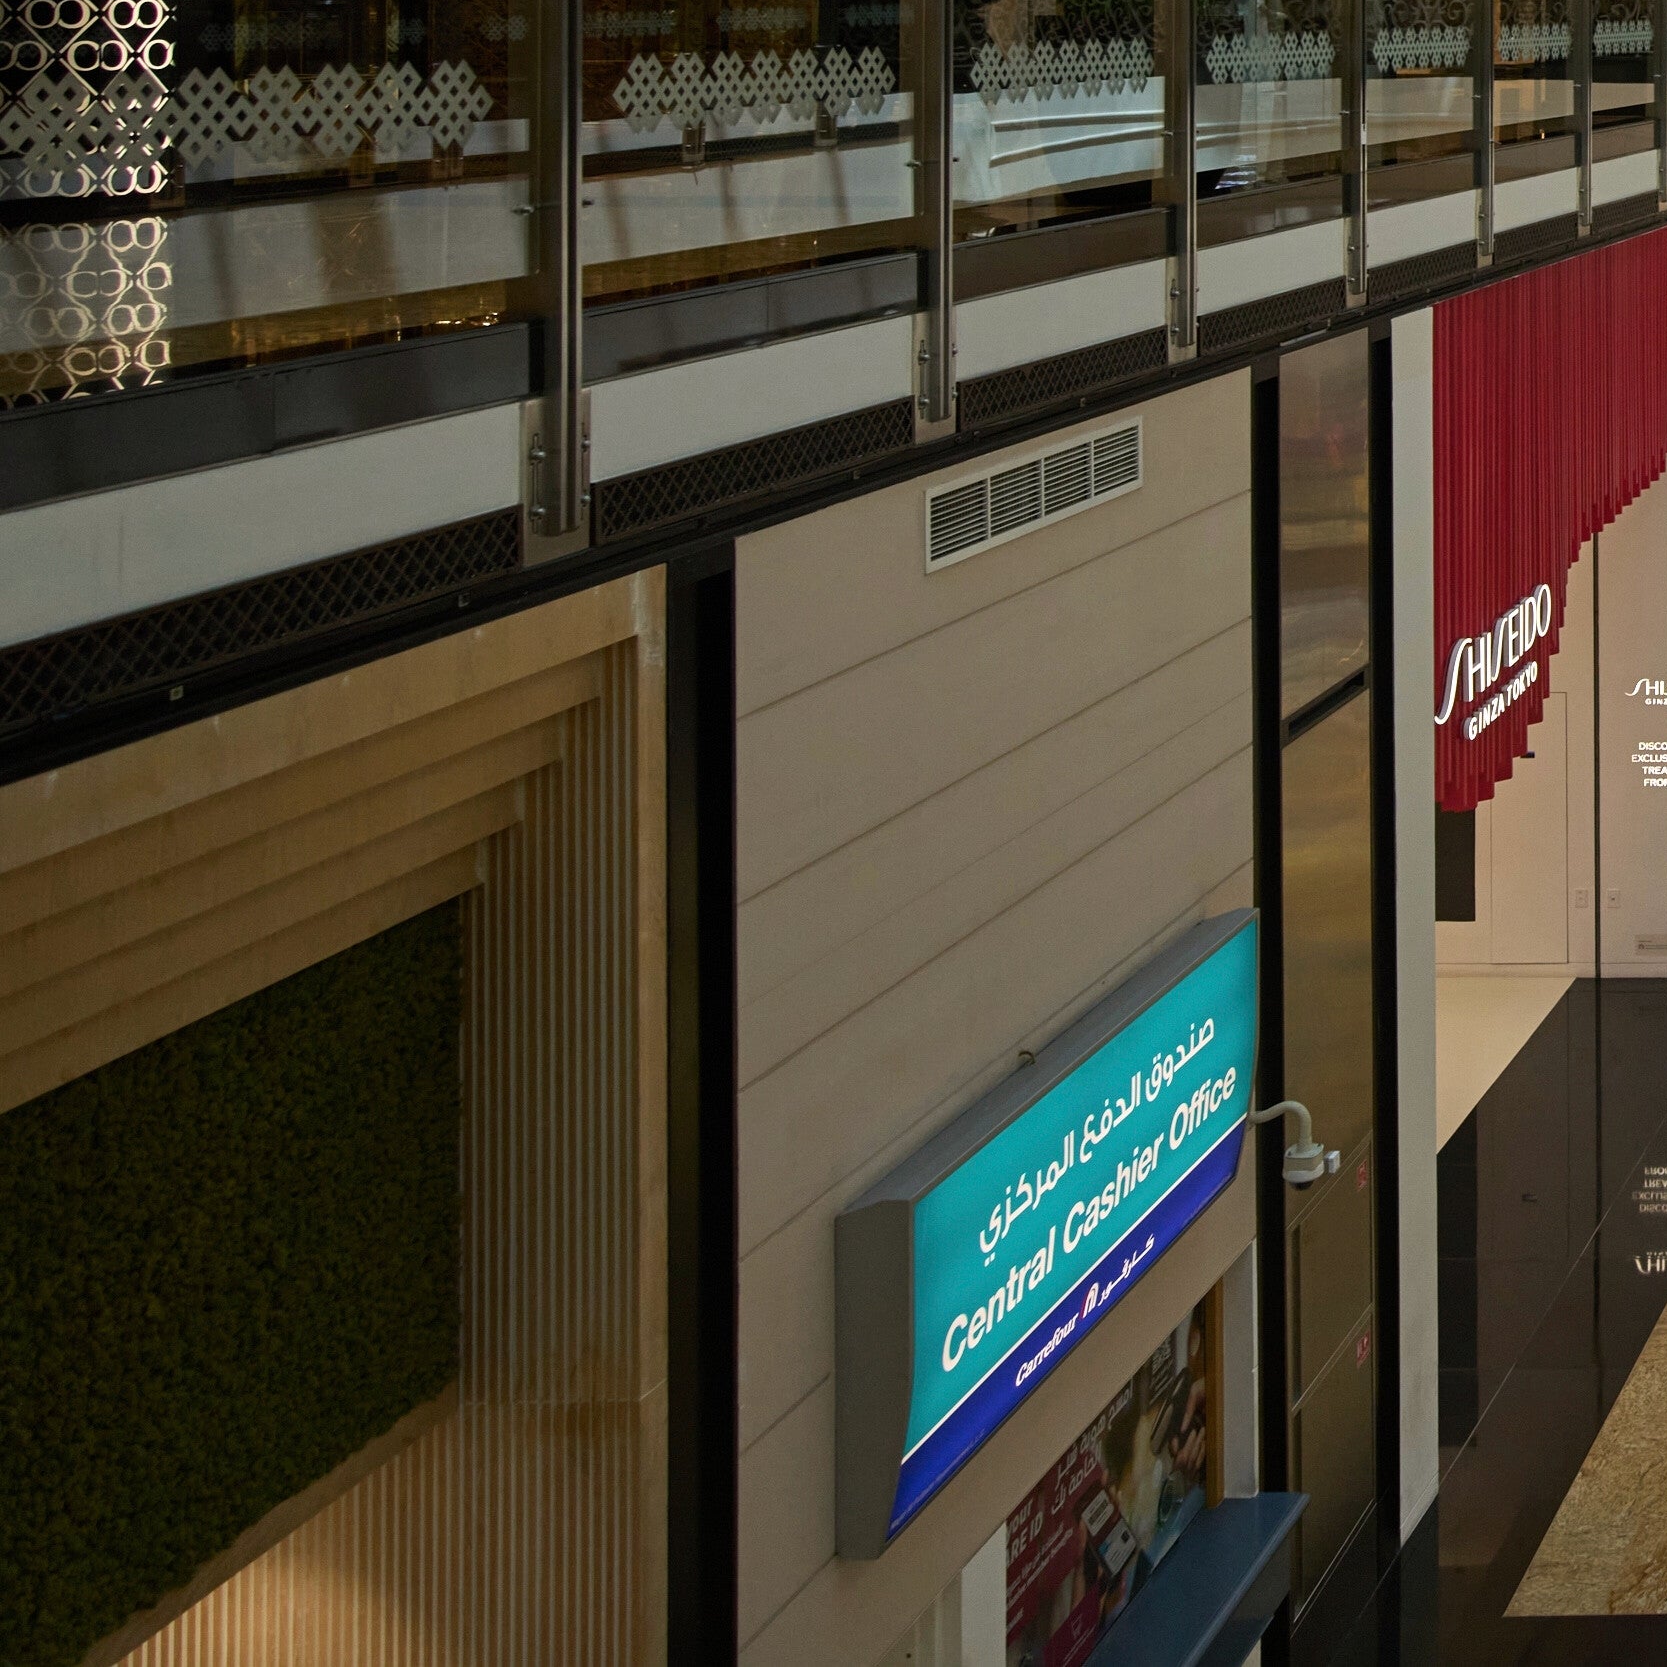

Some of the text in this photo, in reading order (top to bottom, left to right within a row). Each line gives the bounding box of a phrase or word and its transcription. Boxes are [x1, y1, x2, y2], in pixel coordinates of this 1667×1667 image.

[1434, 583, 1552, 725] SHISEIDO
[1464, 660, 1538, 741] GINZA TOKYO
[980, 1018, 1214, 1267] صندوق الدفع المركزي
[942, 1225, 1056, 1372] Central
[1063, 1133, 1164, 1254] Cashier
[1169, 1066, 1236, 1150] Office
[1015, 1313, 1079, 1387] Carrefour
